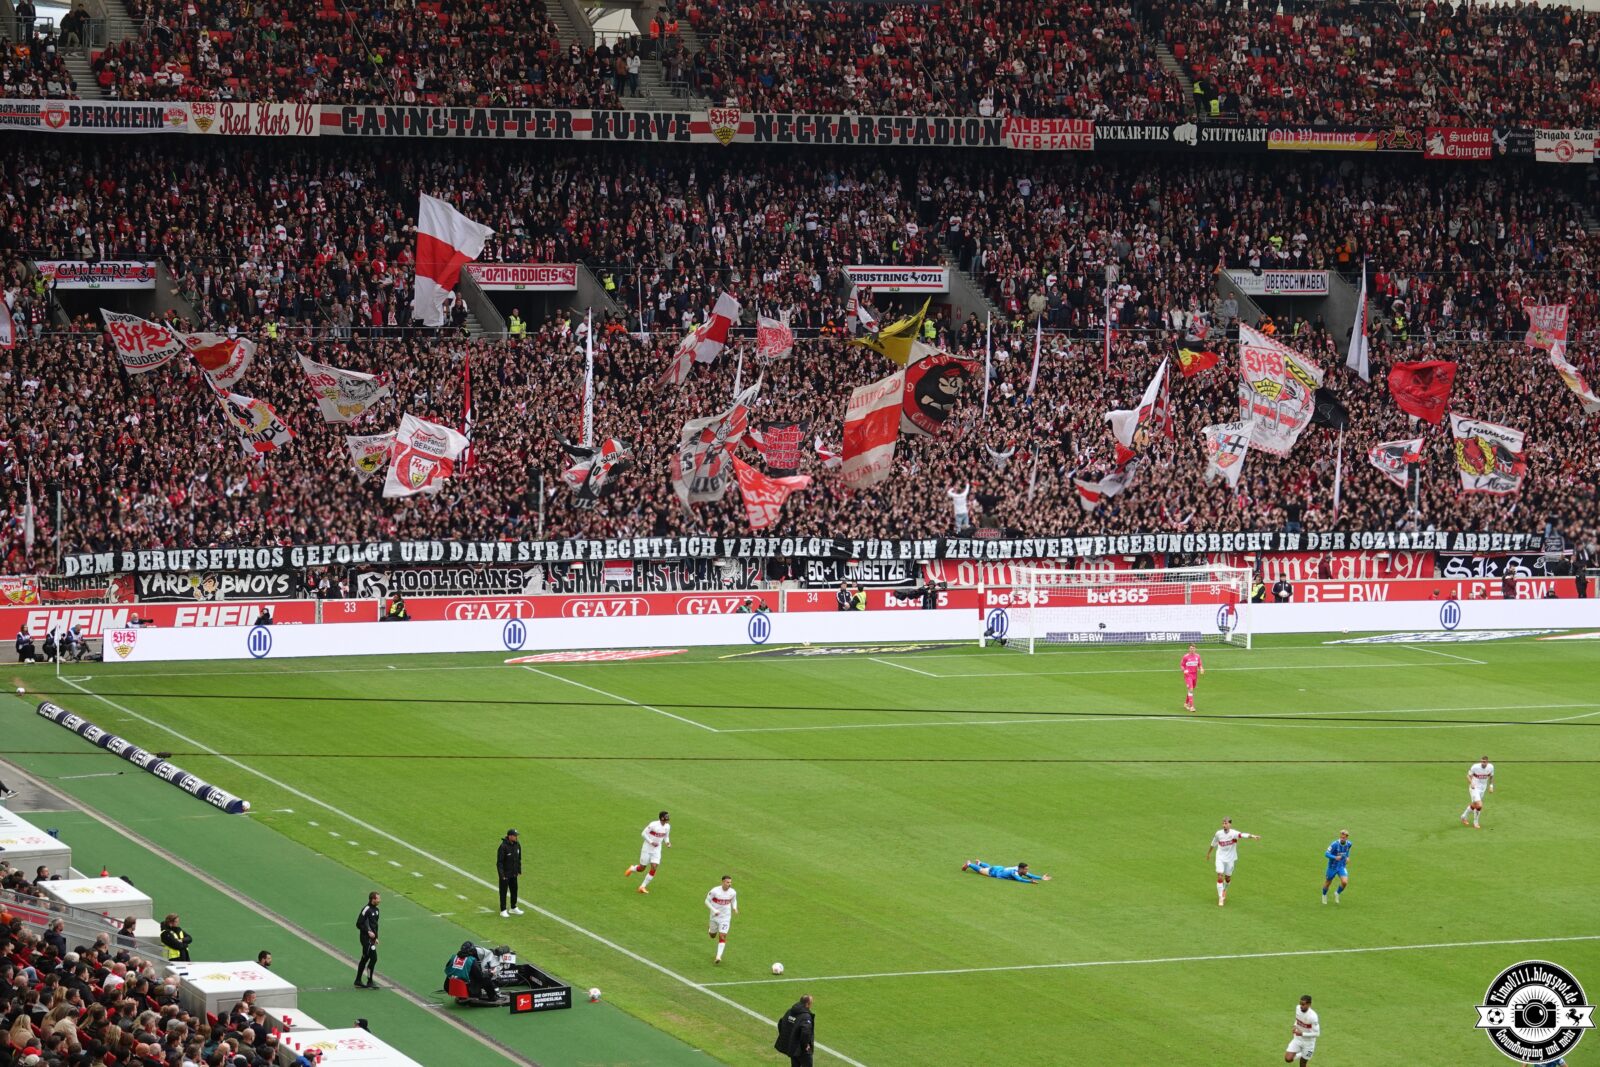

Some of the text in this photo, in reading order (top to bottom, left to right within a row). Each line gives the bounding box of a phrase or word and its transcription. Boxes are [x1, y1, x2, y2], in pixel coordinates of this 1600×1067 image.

[68, 105, 164, 128] BERKHEIM
[220, 101, 314, 136] Red Hots 96
[591, 111, 691, 141] KURVE
[754, 114, 1003, 146] NECKARSTADION
[1009, 119, 1092, 134] ALBSTADT
[1011, 135, 1092, 150] VFB-FANS
[1095, 126, 1268, 143] NECKAR-FILS STUTTGART
[1298, 128, 1356, 145] Warriors
[1449, 131, 1490, 143] Suebia
[1535, 130, 1570, 142] Brigada
[1574, 130, 1594, 141] Loca
[58, 263, 132, 278] GALEERE
[486, 268, 558, 282] 0711 ADDICTS
[850, 273, 943, 283] BRUSTRING 0711
[73, 275, 115, 285] CANNSTATT
[1265, 273, 1326, 290] OBERSCHWABEN
[64, 552, 115, 577] DEM
[121, 547, 284, 572] BERUFSETHOS
[290, 543, 393, 568] GEFOLGT
[399, 541, 444, 563] UND
[450, 541, 512, 563] DANN
[518, 537, 717, 562] STRAFRECHTLICH
[722, 537, 834, 559] VERFOLGT
[900, 539, 938, 560] EIN
[1279, 532, 1302, 552] IN
[1307, 532, 1346, 552] DER
[1349, 531, 1449, 551] SOZIALEN
[1453, 532, 1532, 552] ARBEIT!
[808, 560, 838, 581] 50+1
[139, 573, 290, 596] YARD BWOYS
[388, 569, 522, 591] HOOLIGANS
[807, 593, 819, 603] 34
[986, 590, 1050, 606] bet365
[1086, 589, 1150, 604] bet365
[344, 603, 357, 613] 33
[26, 609, 130, 636] EHEIM
